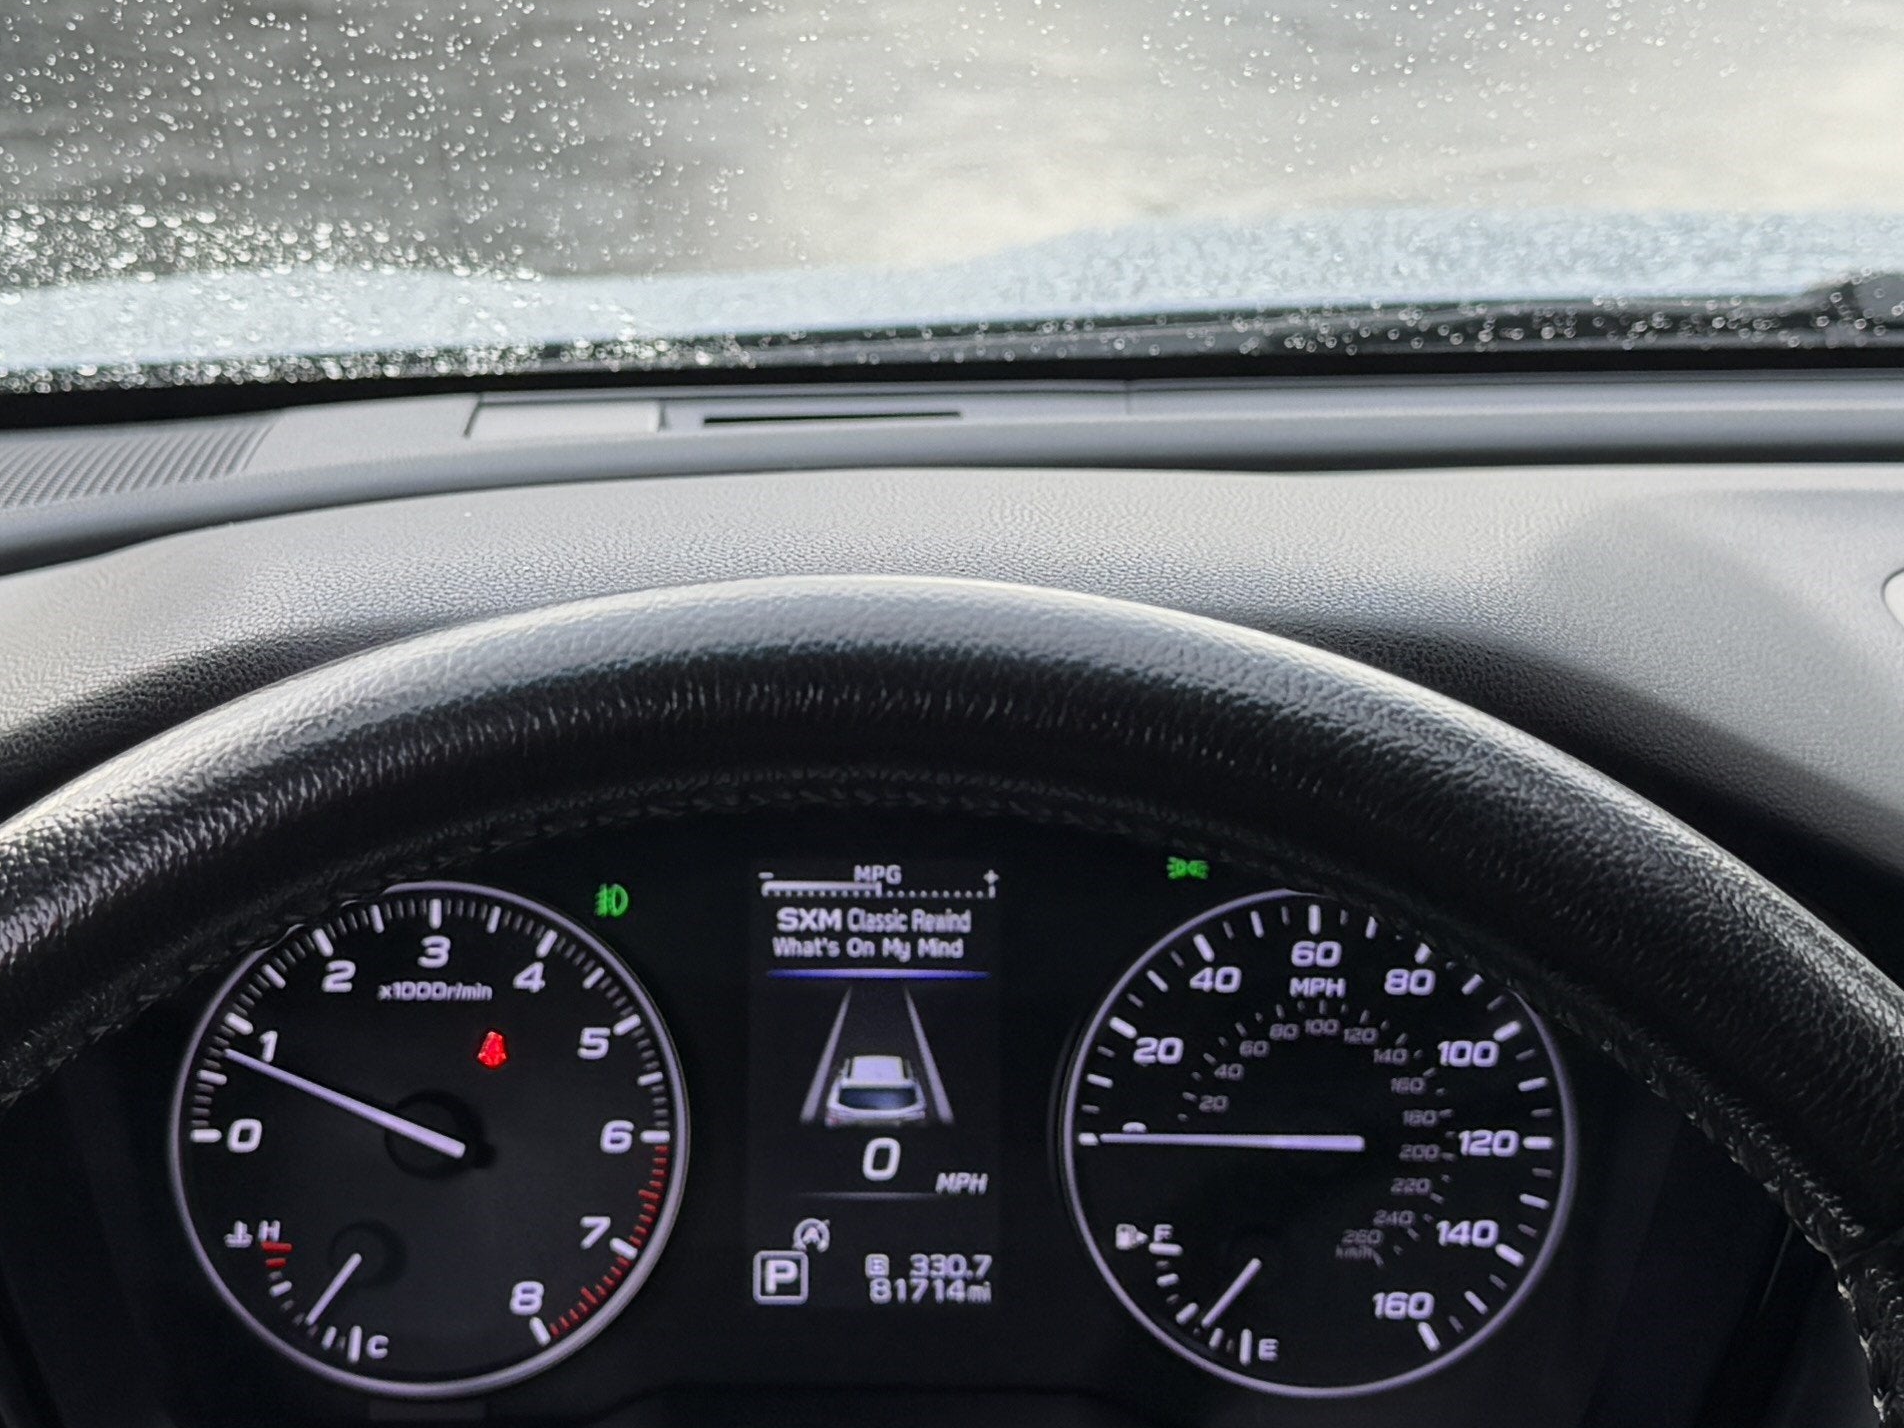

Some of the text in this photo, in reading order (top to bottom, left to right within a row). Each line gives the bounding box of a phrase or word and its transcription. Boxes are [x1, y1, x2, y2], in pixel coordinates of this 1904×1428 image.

[854, 865, 901, 884] MPG
[776, 908, 971, 933] SXM Classic Rewind
[417, 936, 451, 968] 3
[773, 937, 963, 962] What's On My Mind
[1290, 941, 1342, 968] 60
[322, 961, 356, 992] 2
[513, 962, 546, 992] 4
[1190, 967, 1242, 993] 40
[1289, 977, 1346, 997] MPH
[1384, 968, 1435, 996] 80
[377, 981, 492, 1002] x1000r/min
[1304, 1019, 1340, 1035] 100
[259, 1030, 278, 1062] 1
[577, 1027, 611, 1060] 5
[1133, 1037, 1183, 1064] 20
[1239, 1041, 1269, 1058] 60
[1438, 1041, 1499, 1067] 100
[1214, 1064, 1245, 1080] 40
[1199, 1095, 1229, 1113] 20
[227, 1119, 262, 1153] 0
[600, 1120, 634, 1153] 6
[1458, 1130, 1518, 1157] 120
[862, 1137, 901, 1181] 0
[936, 1173, 988, 1194] MPH
[258, 1220, 280, 1242] H
[580, 1216, 611, 1249] 7
[1436, 1220, 1498, 1247] 140
[764, 1260, 797, 1294] P
[909, 1254, 992, 1279] 330.7
[509, 1282, 544, 1315] 8
[1373, 1292, 1434, 1319] 160
[366, 1336, 389, 1358] C
[1259, 1338, 1279, 1360] E
